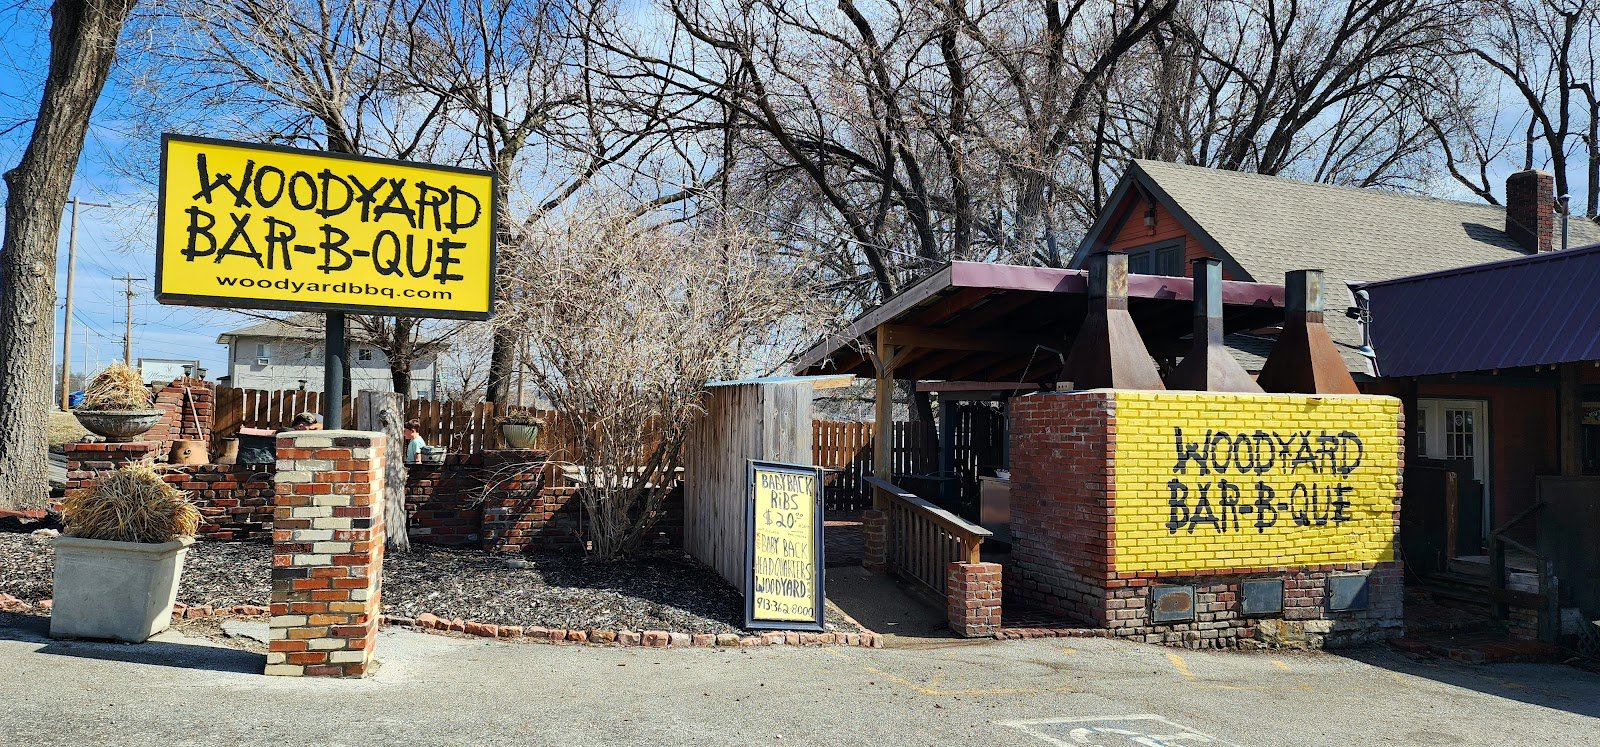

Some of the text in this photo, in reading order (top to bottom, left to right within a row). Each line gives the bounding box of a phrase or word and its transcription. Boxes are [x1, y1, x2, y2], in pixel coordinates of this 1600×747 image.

[192, 153, 482, 235] WOODYARD
[181, 206, 467, 285] BAR-B-QUE
[216, 276, 452, 300] woodyardbbq.com
[1173, 426, 1364, 479] WOODYARD
[1165, 478, 1355, 535] BAR-B-QUE
[761, 534, 779, 555] BABY
[783, 538, 808, 560] BACK
[755, 556, 812, 581] HEADQUARTERS
[755, 575, 806, 598] WOODYARD
